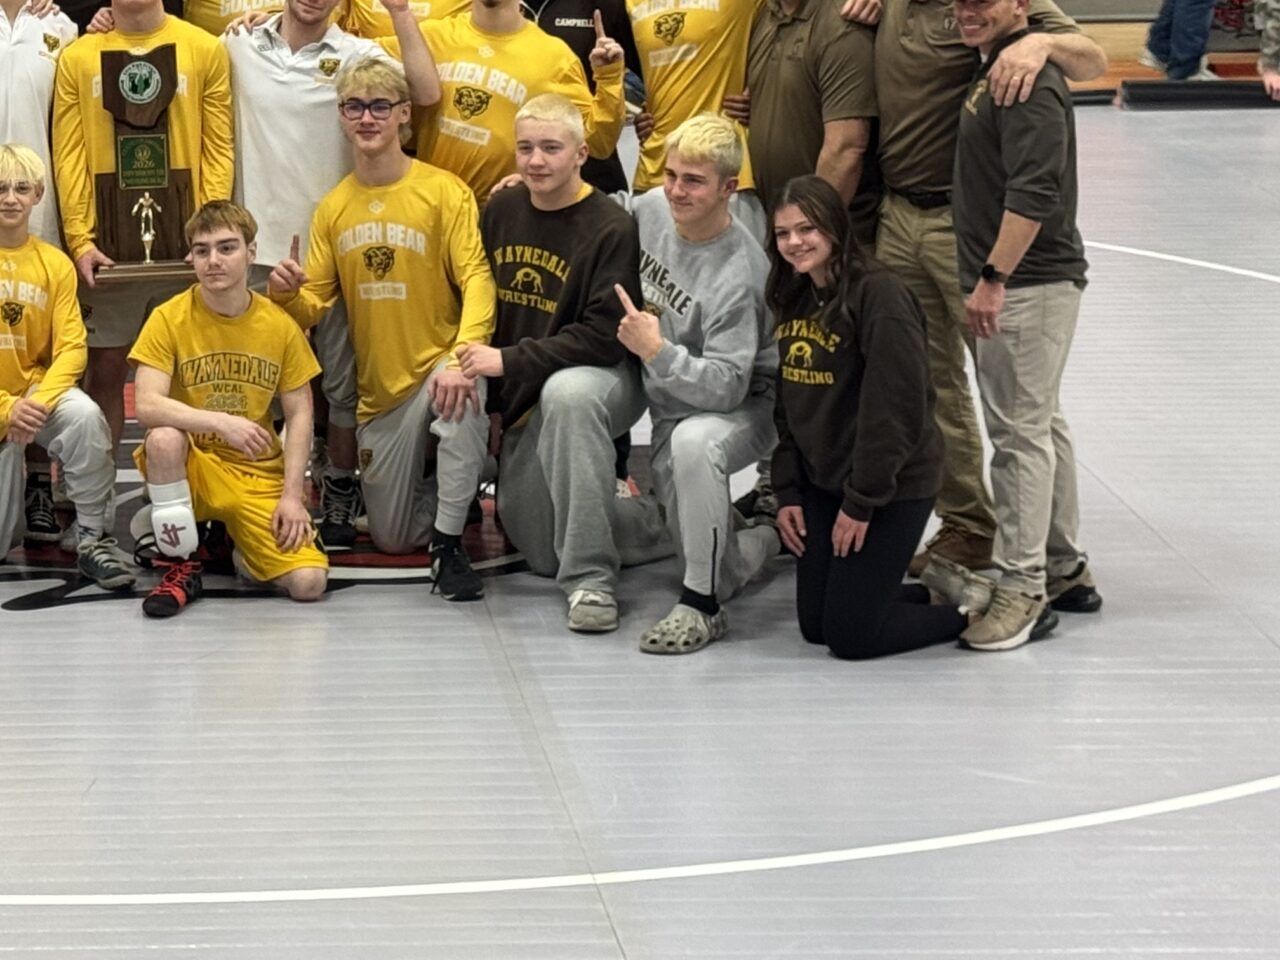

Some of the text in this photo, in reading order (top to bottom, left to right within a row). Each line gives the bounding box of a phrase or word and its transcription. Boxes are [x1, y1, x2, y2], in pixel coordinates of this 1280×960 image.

[489, 68, 528, 107] BEAR
[386, 222, 426, 257] BEAR
[181, 352, 279, 390] WAYNEDALE
